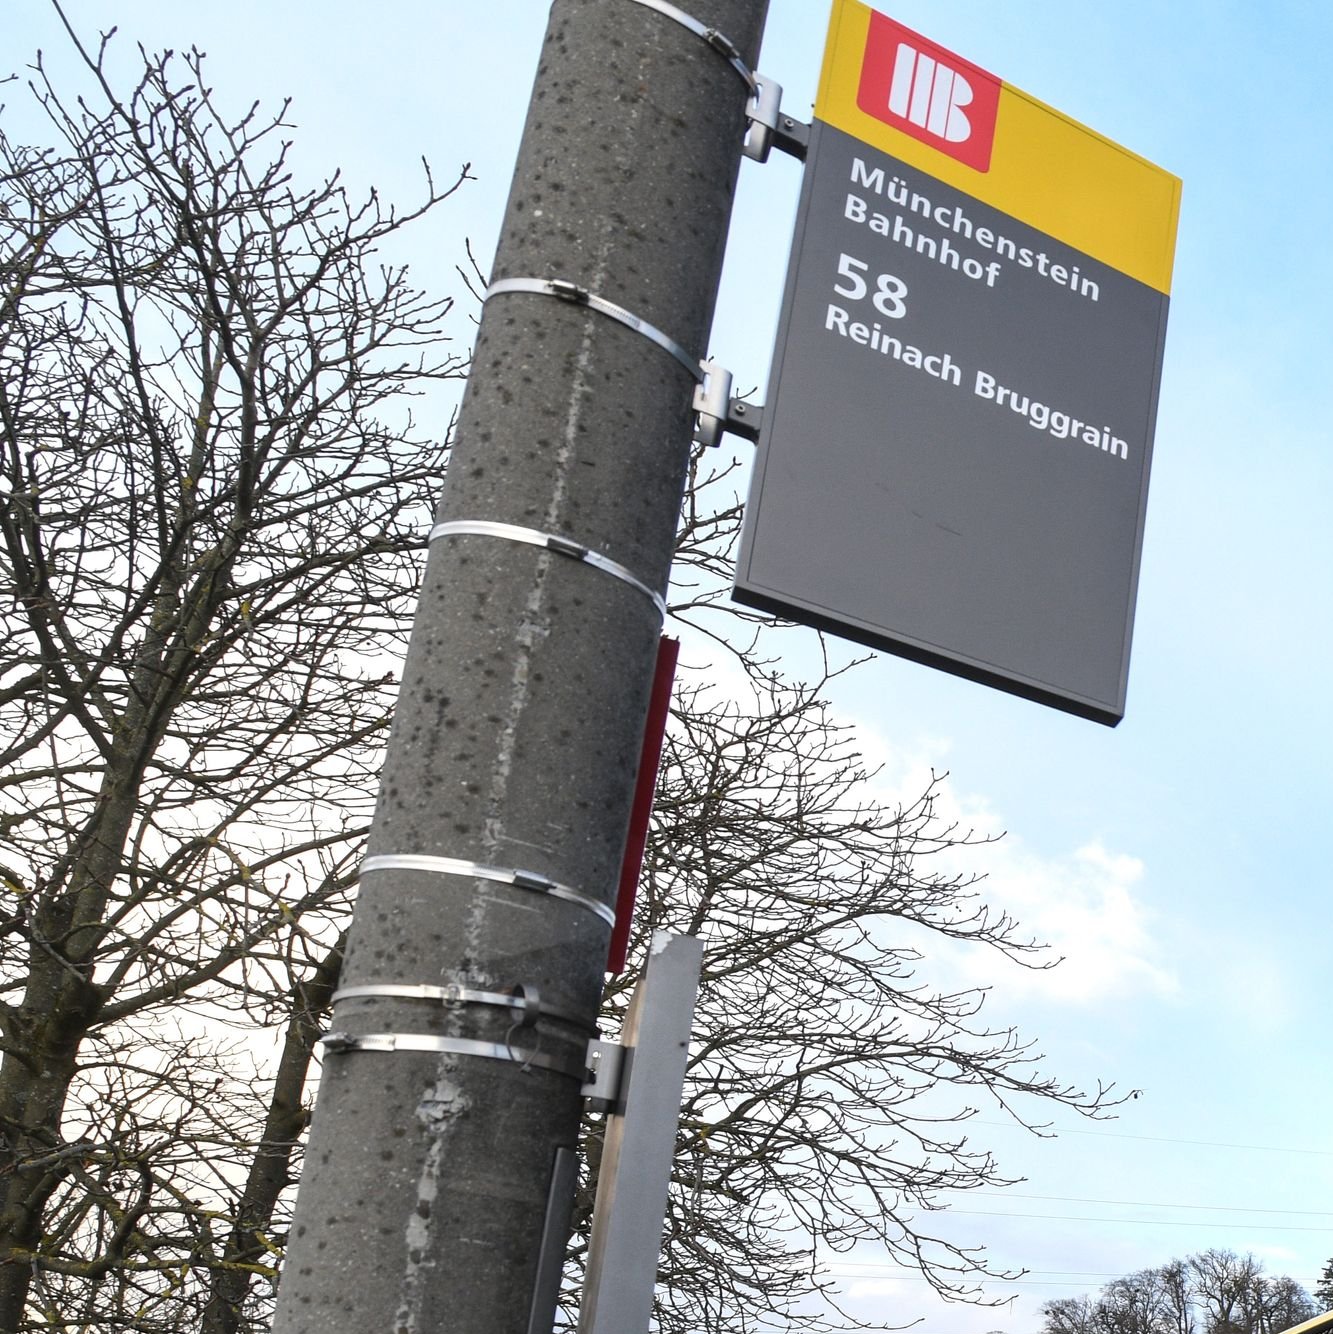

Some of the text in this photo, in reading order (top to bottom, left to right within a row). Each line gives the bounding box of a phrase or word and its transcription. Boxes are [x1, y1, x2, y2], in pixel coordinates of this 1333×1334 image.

[833, 252, 909, 320] 58
[844, 193, 1002, 288] Bahnhof
[850, 157, 1100, 302] Münchenstein
[825, 303, 1129, 461] Reinach Bruggrain
